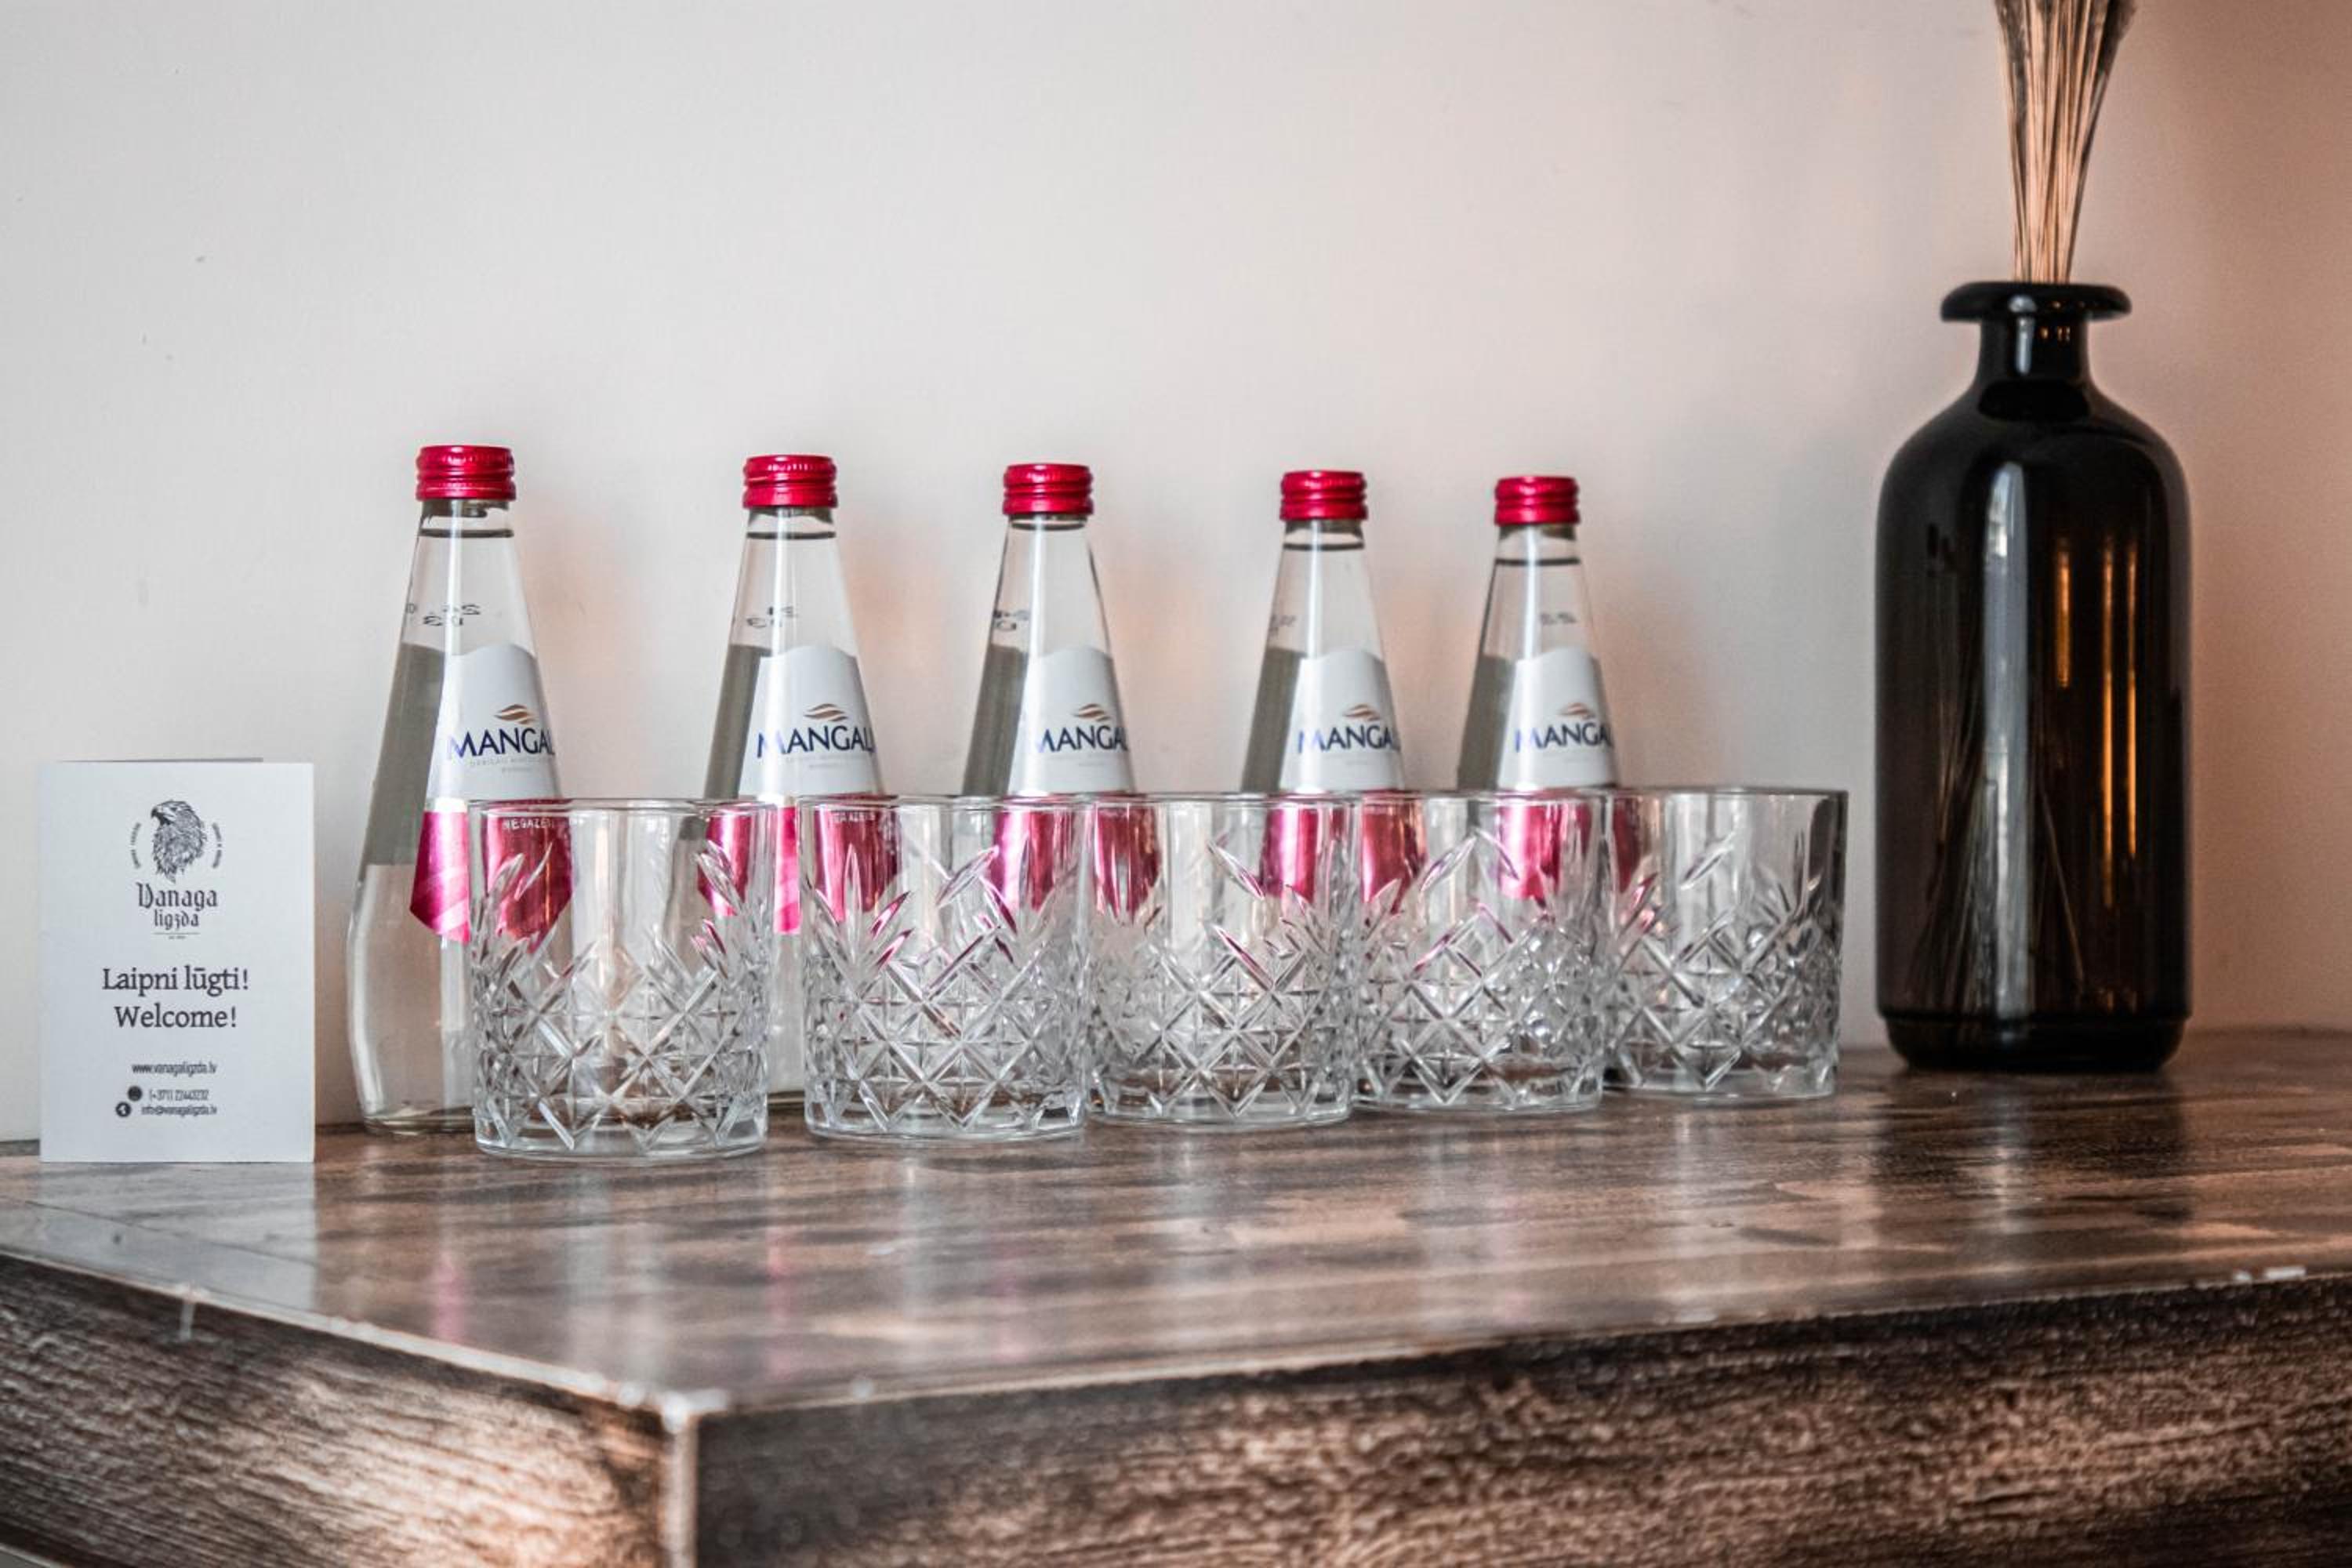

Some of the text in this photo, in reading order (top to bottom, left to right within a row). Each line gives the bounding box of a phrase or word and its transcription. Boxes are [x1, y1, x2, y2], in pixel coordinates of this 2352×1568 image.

[136, 882, 218, 911] Vanaga
[153, 909, 199, 931] ligzda
[102, 965, 250, 997] Laipni lūgti!
[114, 1003, 237, 1028] Welcome!
